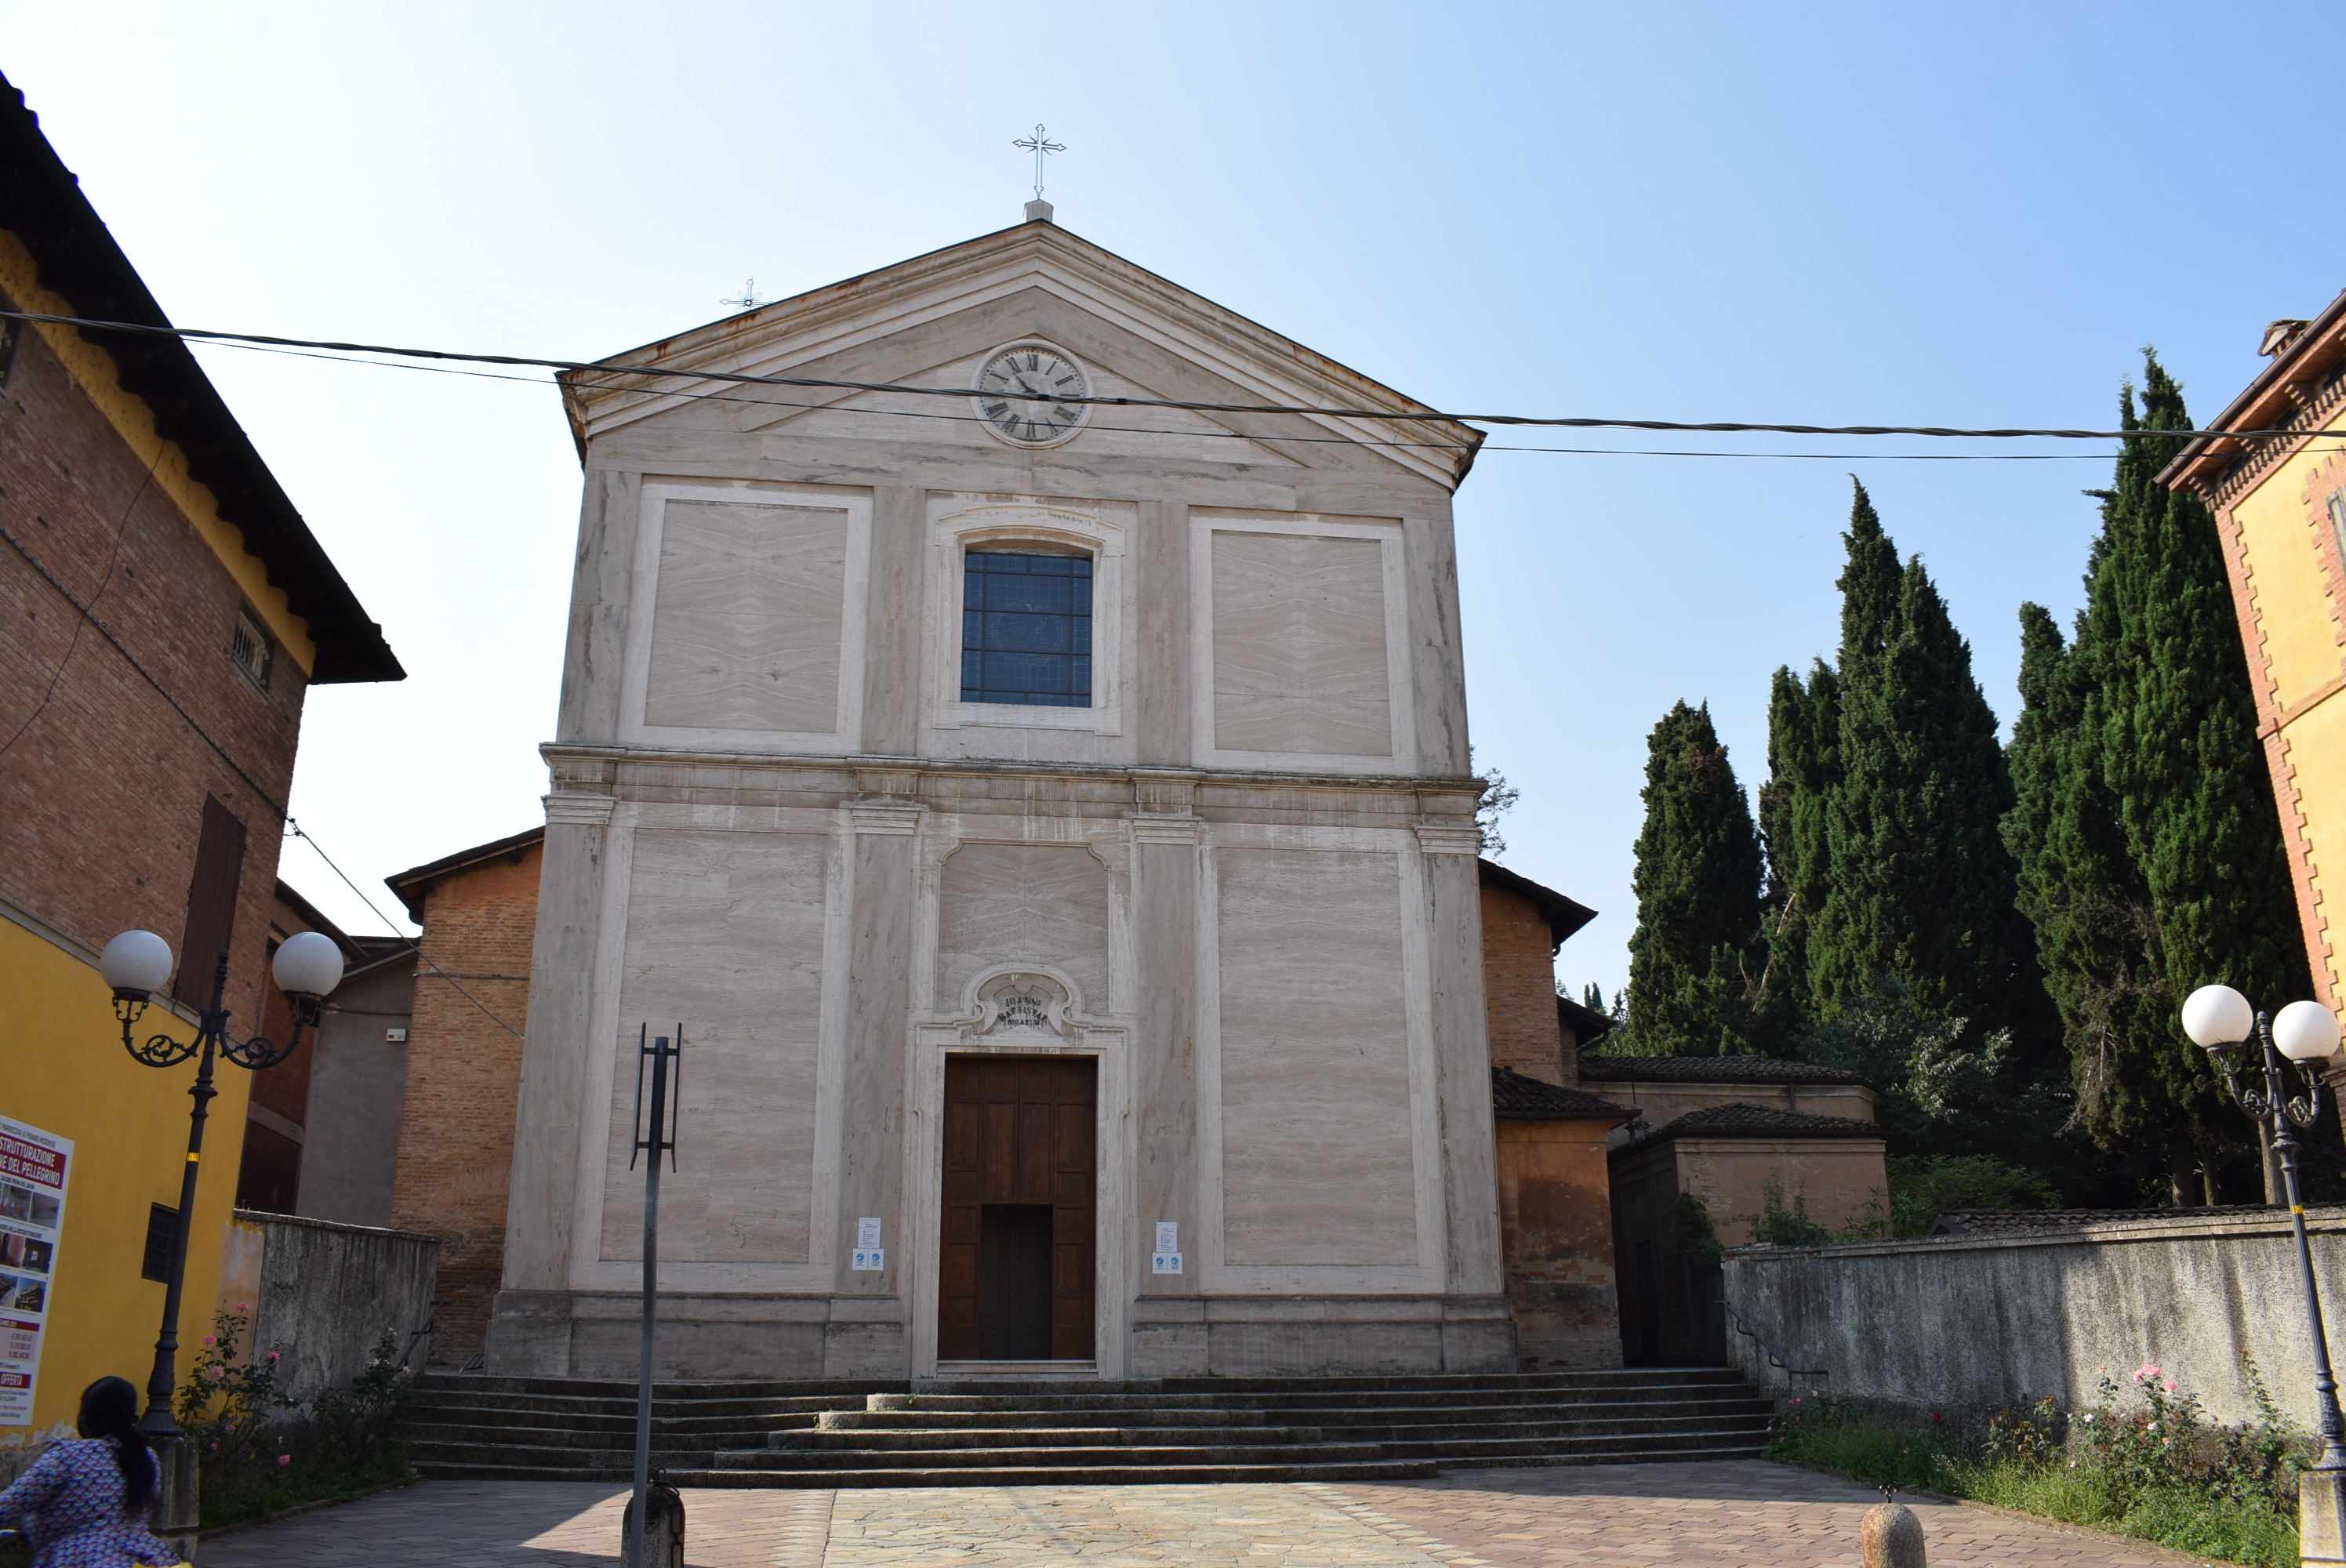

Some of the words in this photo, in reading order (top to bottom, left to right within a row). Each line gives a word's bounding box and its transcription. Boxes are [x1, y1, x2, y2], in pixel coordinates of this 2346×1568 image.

[1004, 357, 1022, 376] XI
[1026, 354, 1039, 372] XII
[1045, 360, 1057, 376] I
[990, 370, 1009, 384] X
[1055, 375, 1074, 387] II
[7, 1156, 20, 1174] DEL
[21, 1161, 60, 1185] PELLEGRINO
[2, 1373, 23, 1386] OFFERTA
